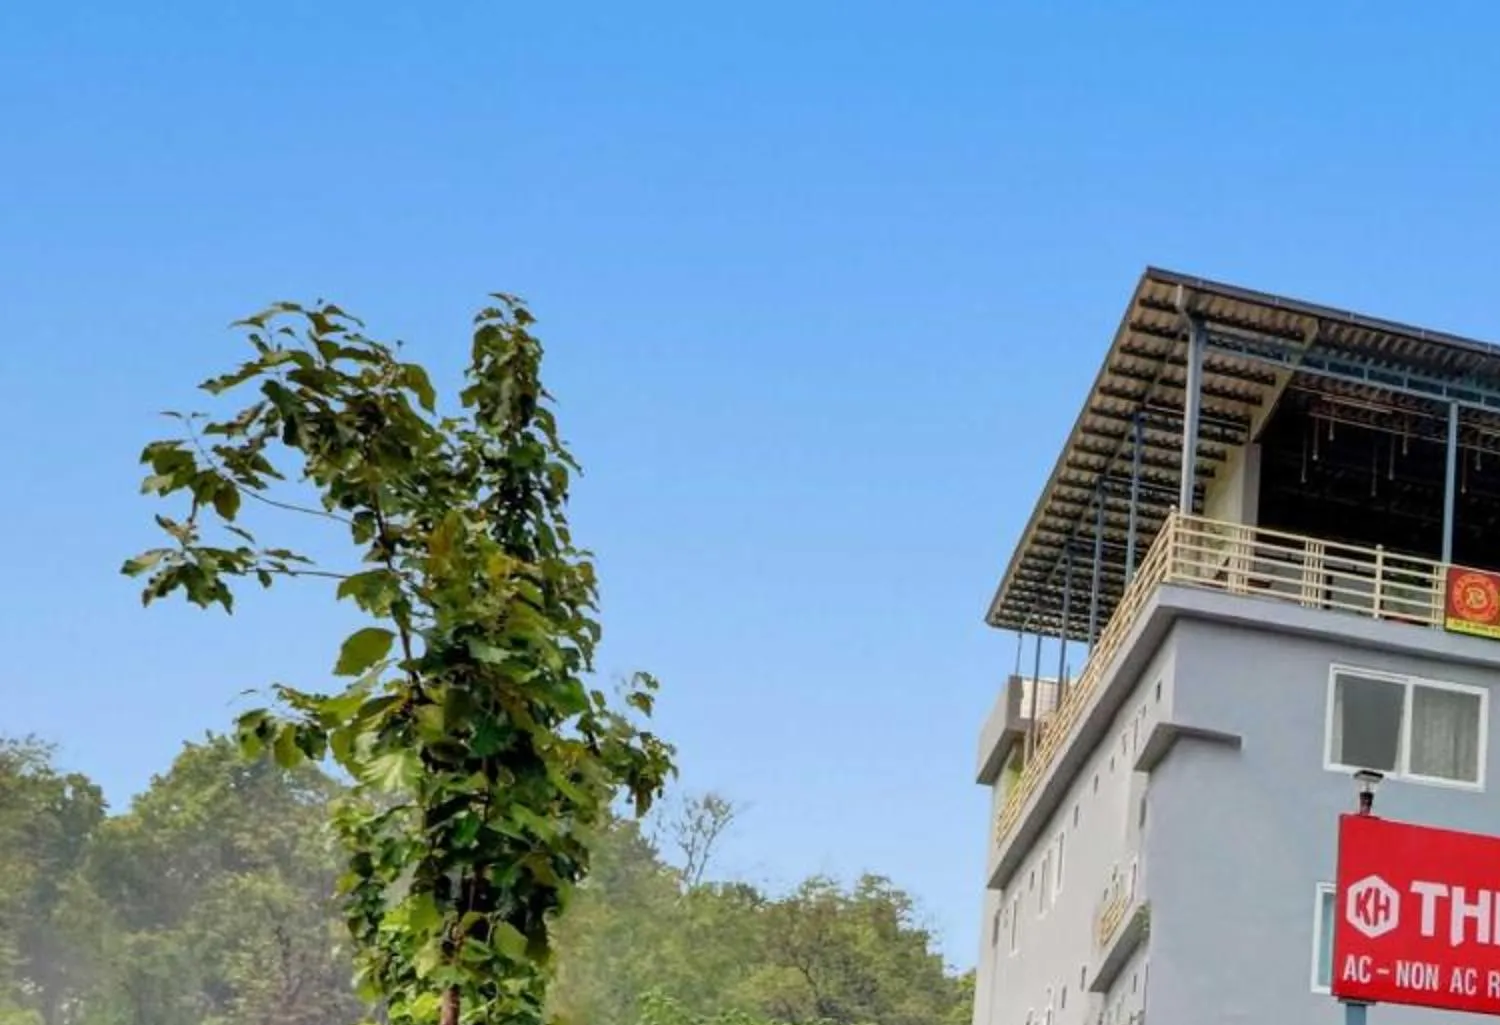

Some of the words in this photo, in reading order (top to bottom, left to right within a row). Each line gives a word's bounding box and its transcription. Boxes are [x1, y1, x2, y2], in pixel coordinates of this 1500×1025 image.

[1343, 954, 1372, 984] AC
[1396, 960, 1440, 992] NON
[1450, 966, 1478, 995] AC
